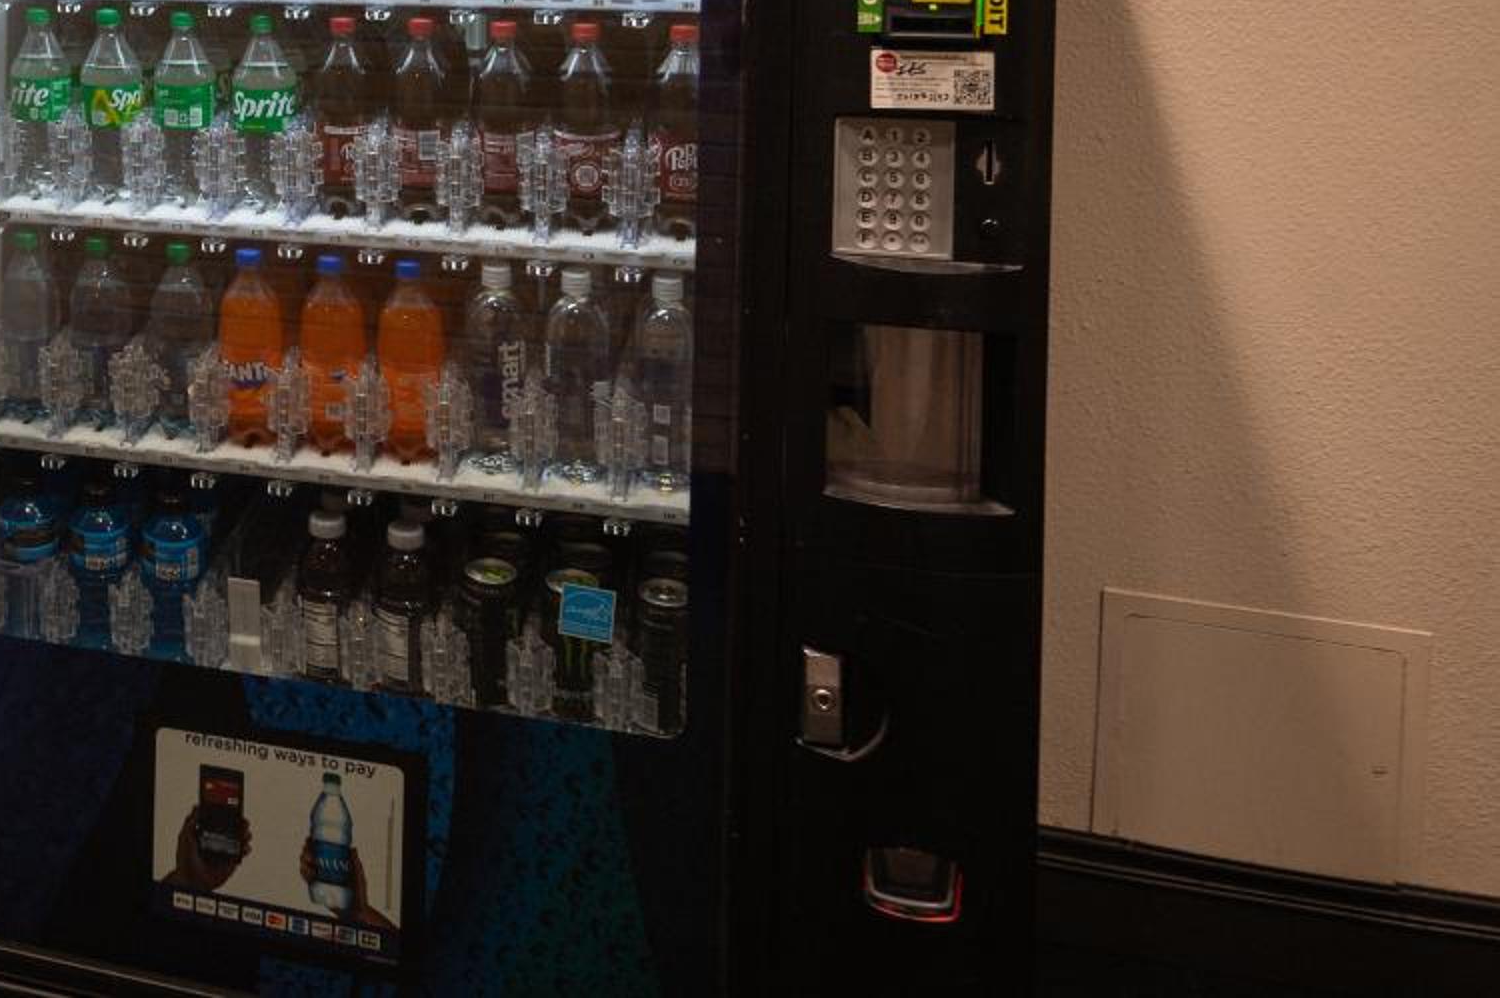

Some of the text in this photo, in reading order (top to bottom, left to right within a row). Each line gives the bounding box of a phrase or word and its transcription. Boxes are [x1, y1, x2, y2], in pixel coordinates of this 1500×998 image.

[185, 732, 377, 779] refreshing ways to pay
